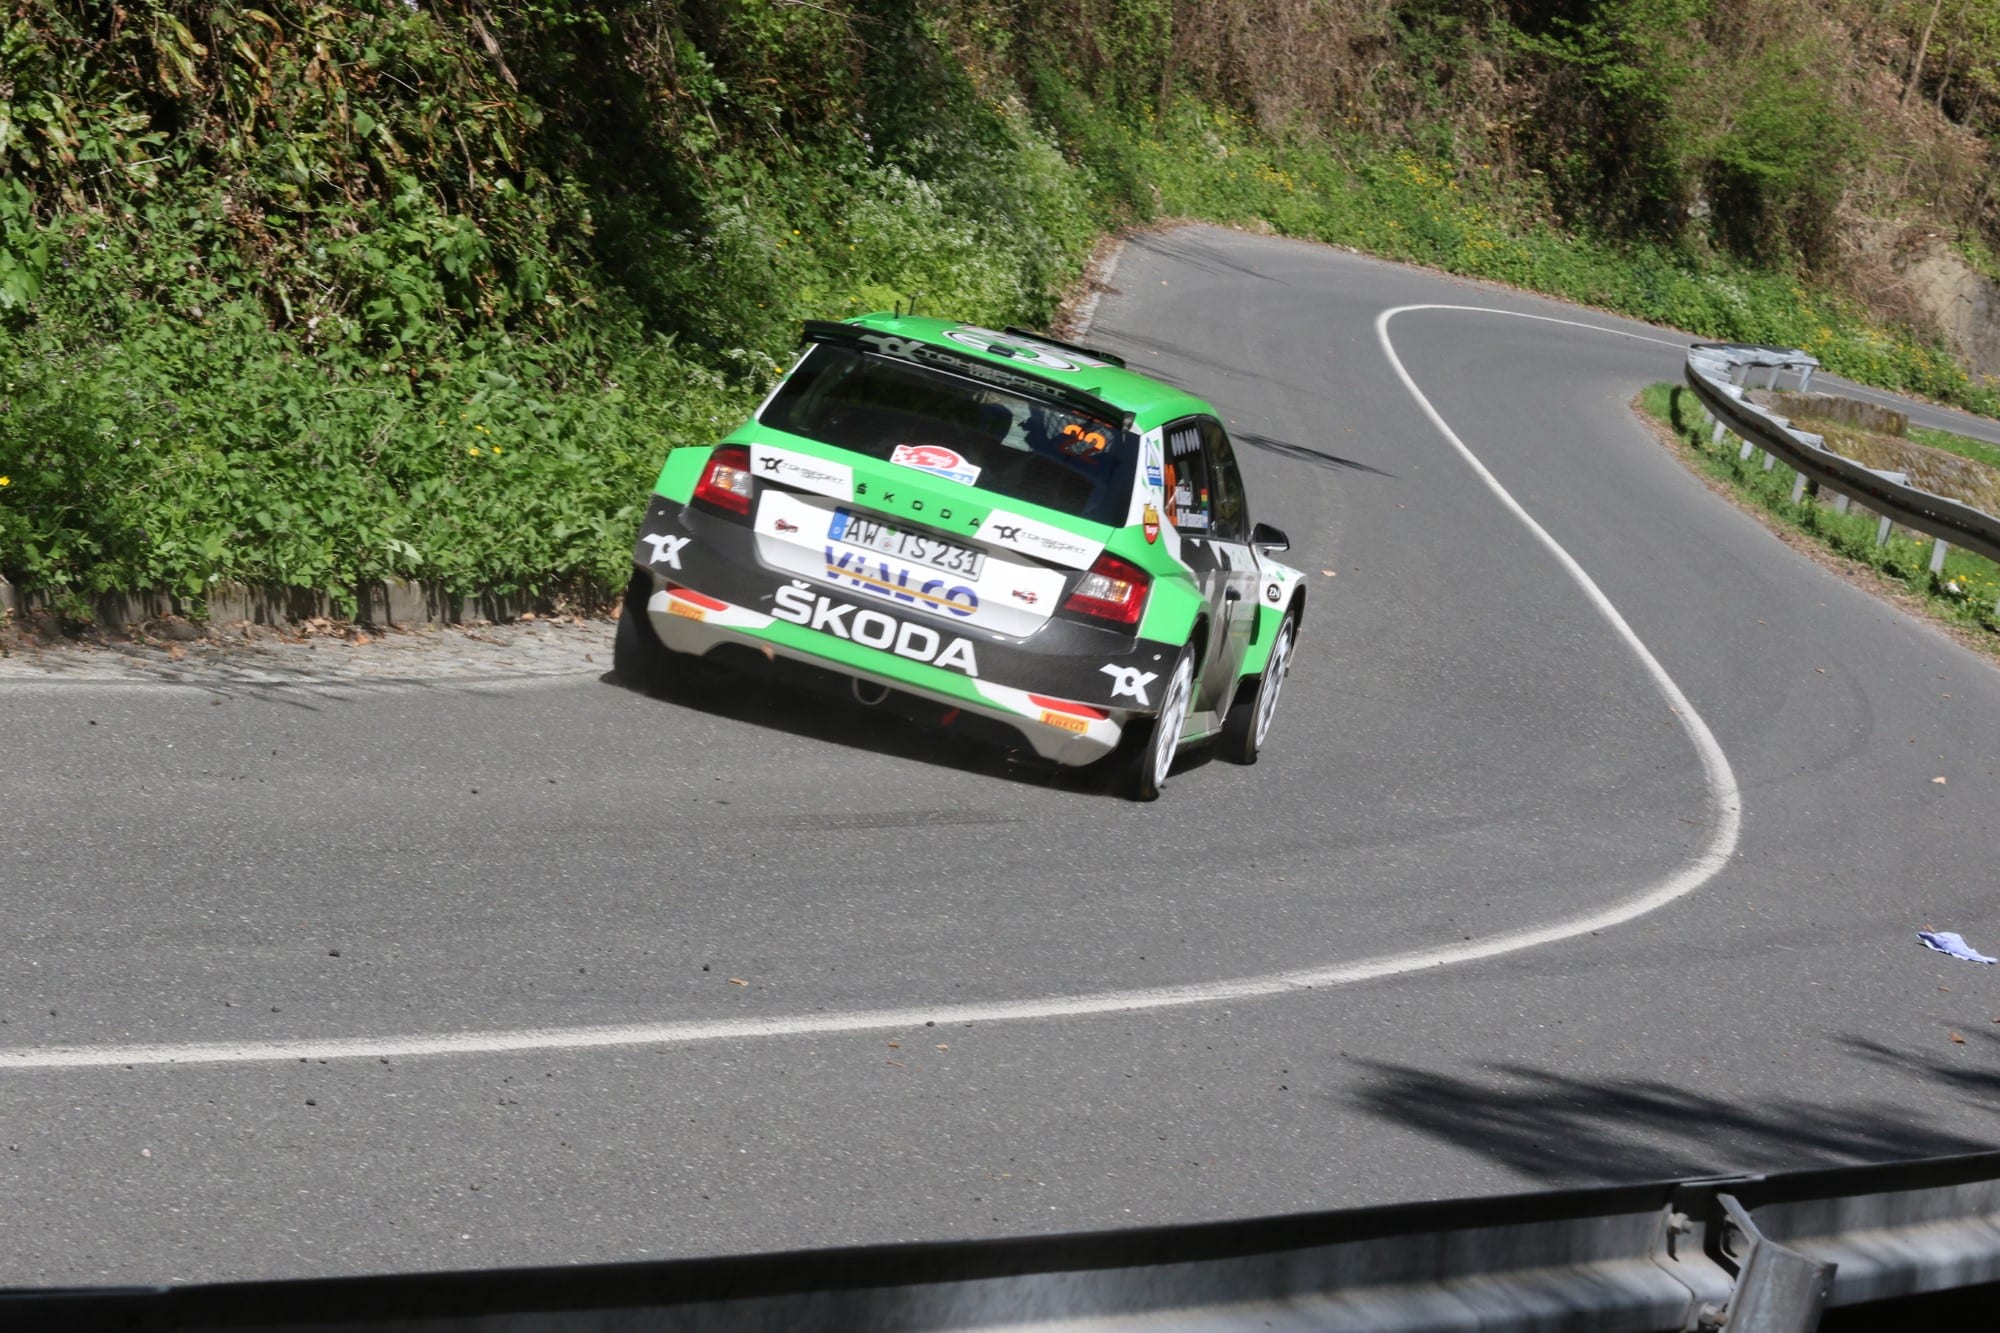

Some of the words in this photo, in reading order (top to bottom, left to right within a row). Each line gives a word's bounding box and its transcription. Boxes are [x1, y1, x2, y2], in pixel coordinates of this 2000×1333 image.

[855, 482, 981, 528] ŠKODA
[844, 516, 882, 546] AW
[897, 529, 930, 559] TS
[931, 540, 980, 576] 231
[771, 580, 979, 677] ŠKODA
[1044, 712, 1086, 732] PIRELLI
